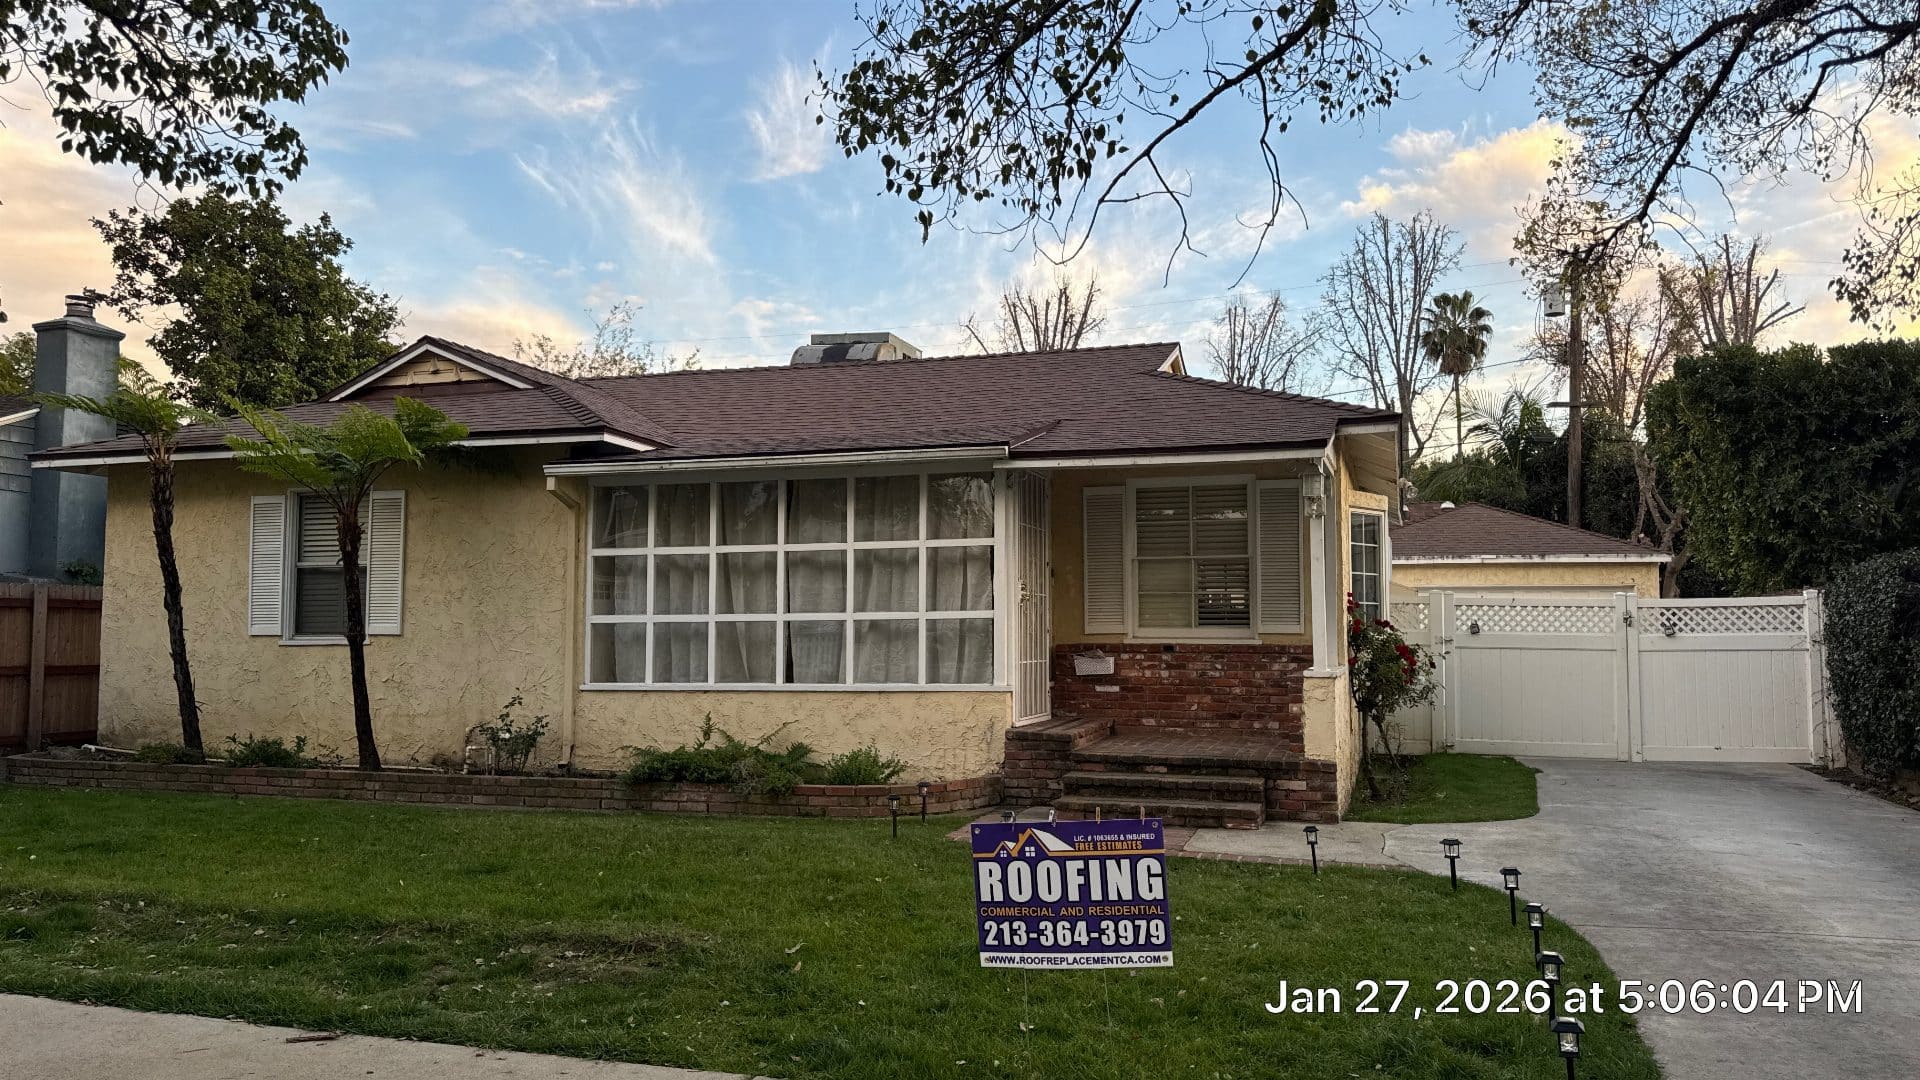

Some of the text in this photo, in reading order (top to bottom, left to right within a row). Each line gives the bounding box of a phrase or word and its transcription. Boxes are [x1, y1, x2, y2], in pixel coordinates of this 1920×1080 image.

[1075, 841, 1143, 851] FREE ESTIMATES
[977, 857, 1165, 903] ROOFING
[980, 905, 1164, 917] COMMERCIAL AND RESIDENTIAL
[983, 919, 1166, 947] 213-364-3979
[989, 954, 1161, 966] WWW.ROOFREPLACEMENTCA.COM
